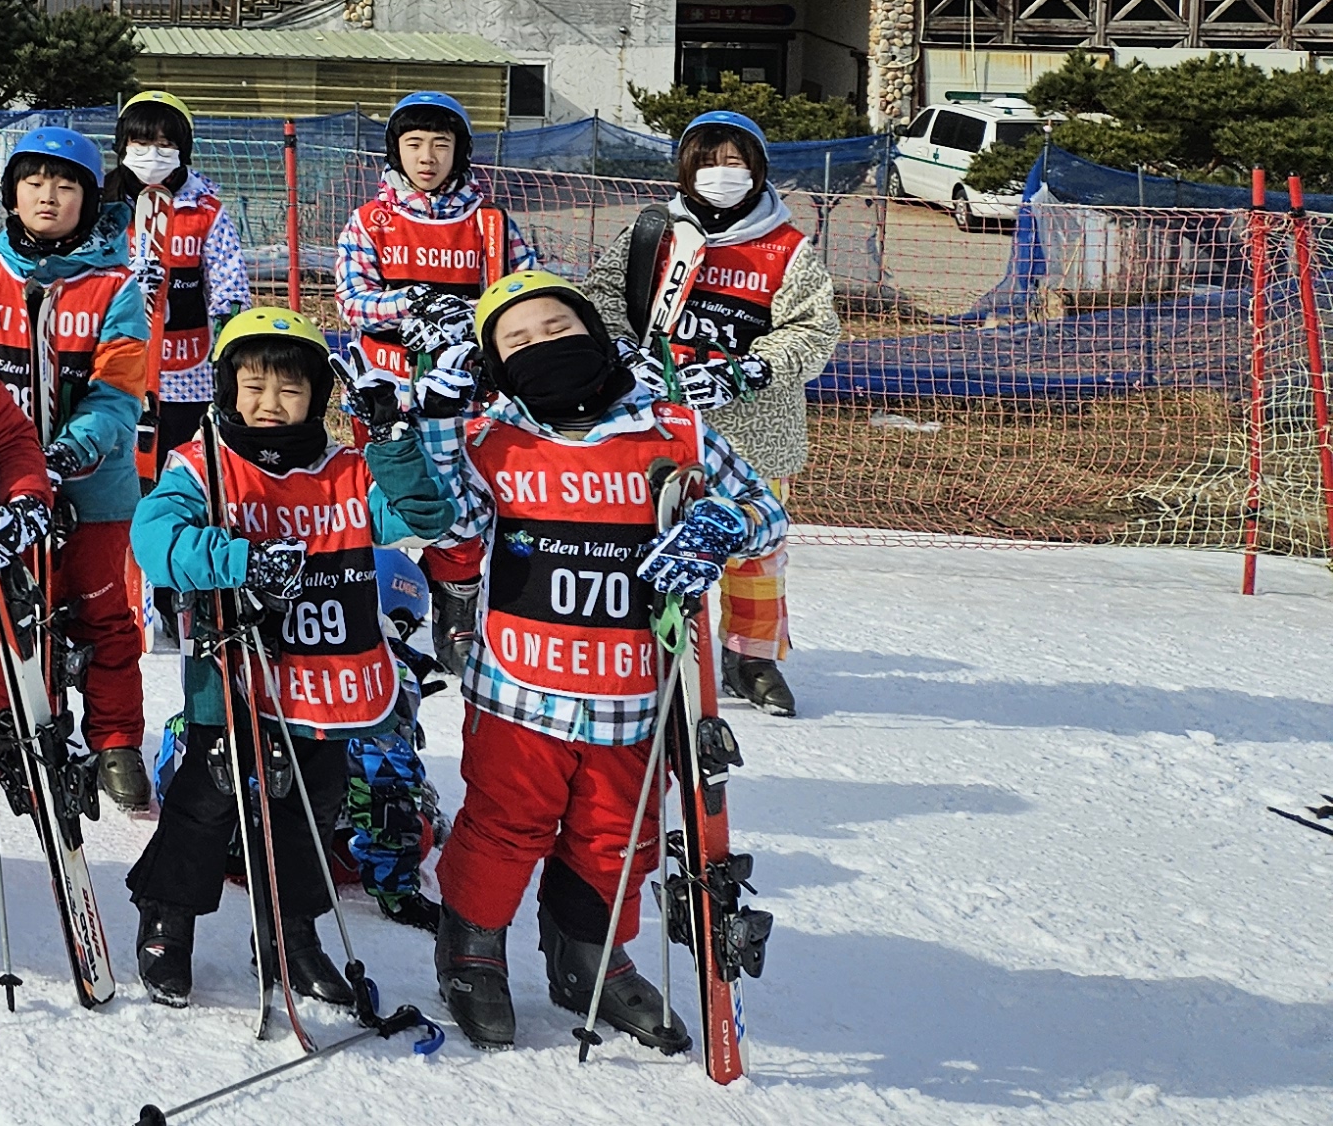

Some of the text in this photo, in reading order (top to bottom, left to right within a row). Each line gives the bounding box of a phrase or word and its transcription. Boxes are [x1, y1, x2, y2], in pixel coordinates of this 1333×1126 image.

[487, 214, 496, 258] HEAD
[382, 247, 481, 269] SKI SCHOOL
[695, 265, 771, 293] SCHOOL
[700, 300, 735, 317] Valley
[495, 470, 648, 505] SKI SCHO
[276, 498, 368, 537] SCHOO
[538, 538, 632, 562] Eden Valley
[550, 567, 630, 619] 070
[500, 627, 653, 679] ONEEIGH
[79, 911, 100, 982] HEAD
[722, 1019, 732, 1074] HEAD
